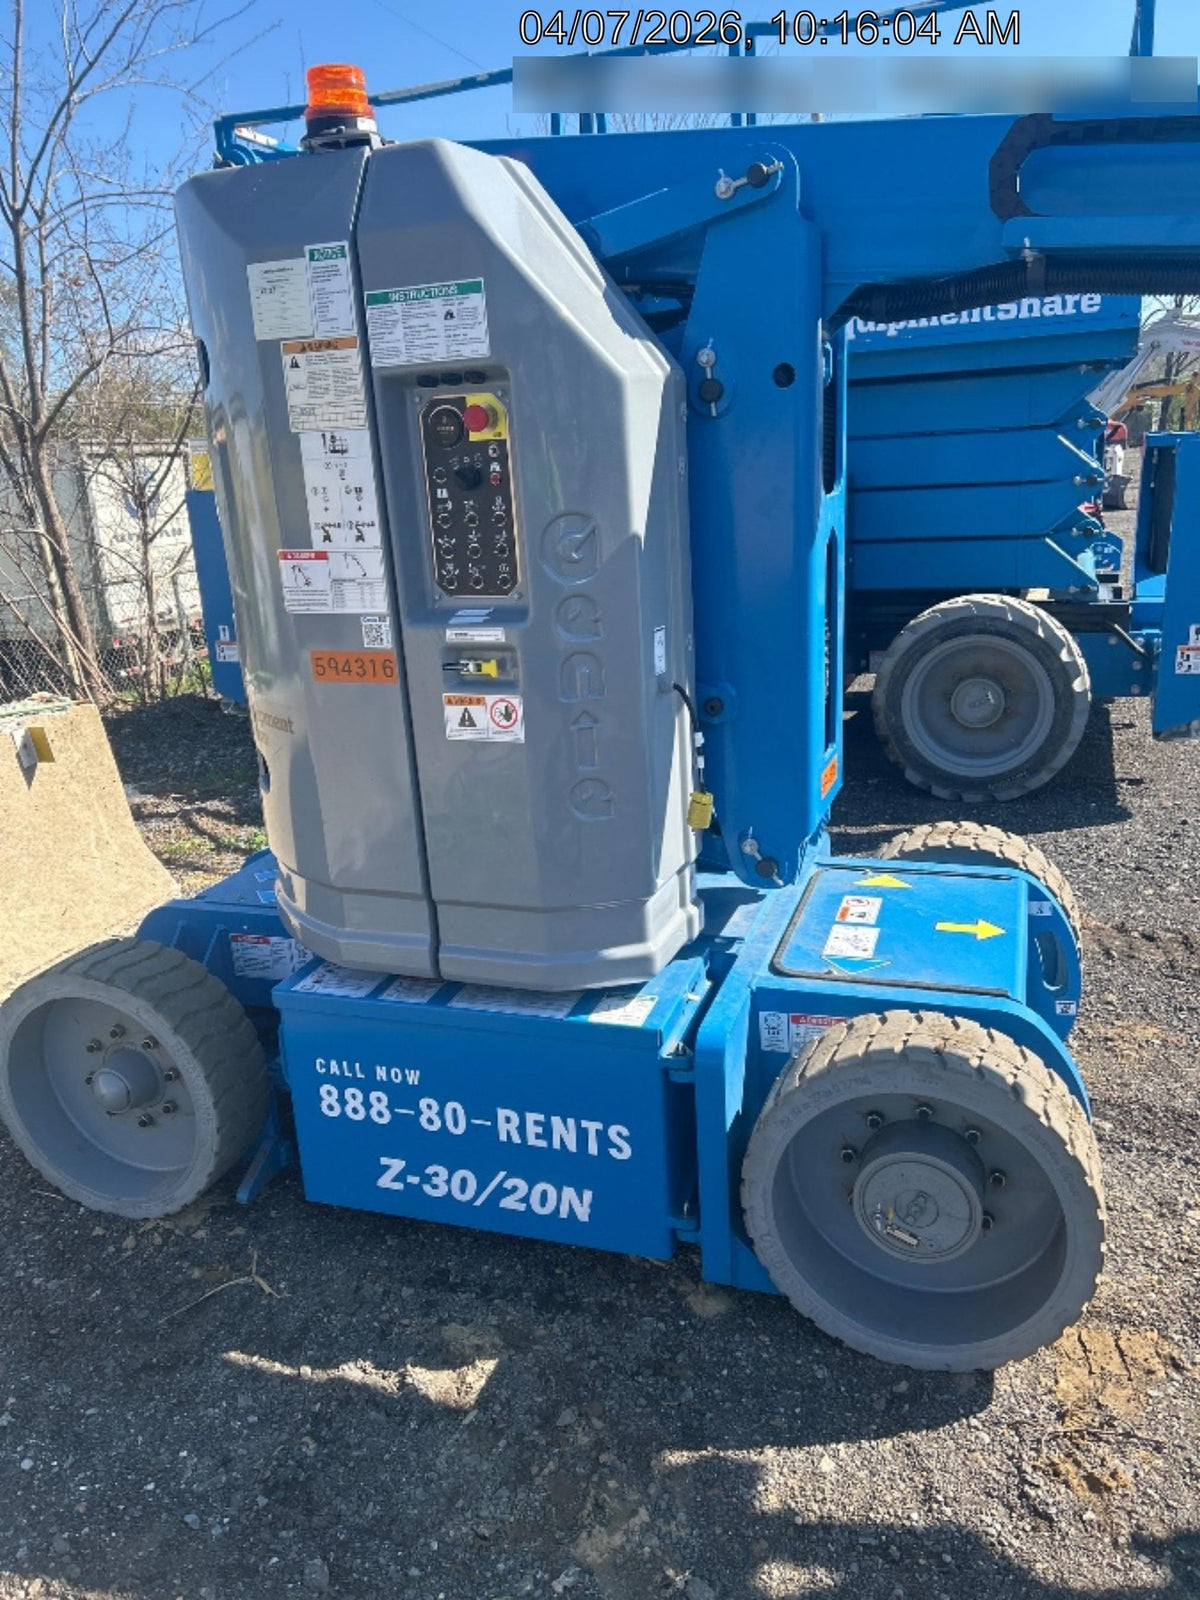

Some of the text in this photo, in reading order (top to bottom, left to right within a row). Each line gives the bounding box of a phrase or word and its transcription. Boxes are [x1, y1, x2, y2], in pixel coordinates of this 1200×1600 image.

[388, 283, 459, 302] INSTRUCTIONS
[314, 657, 394, 678] 594316
[315, 1058, 421, 1086] CALL NOW
[319, 1083, 633, 1161] 888-80-RENTS
[376, 1156, 594, 1223] Z-30/20N
